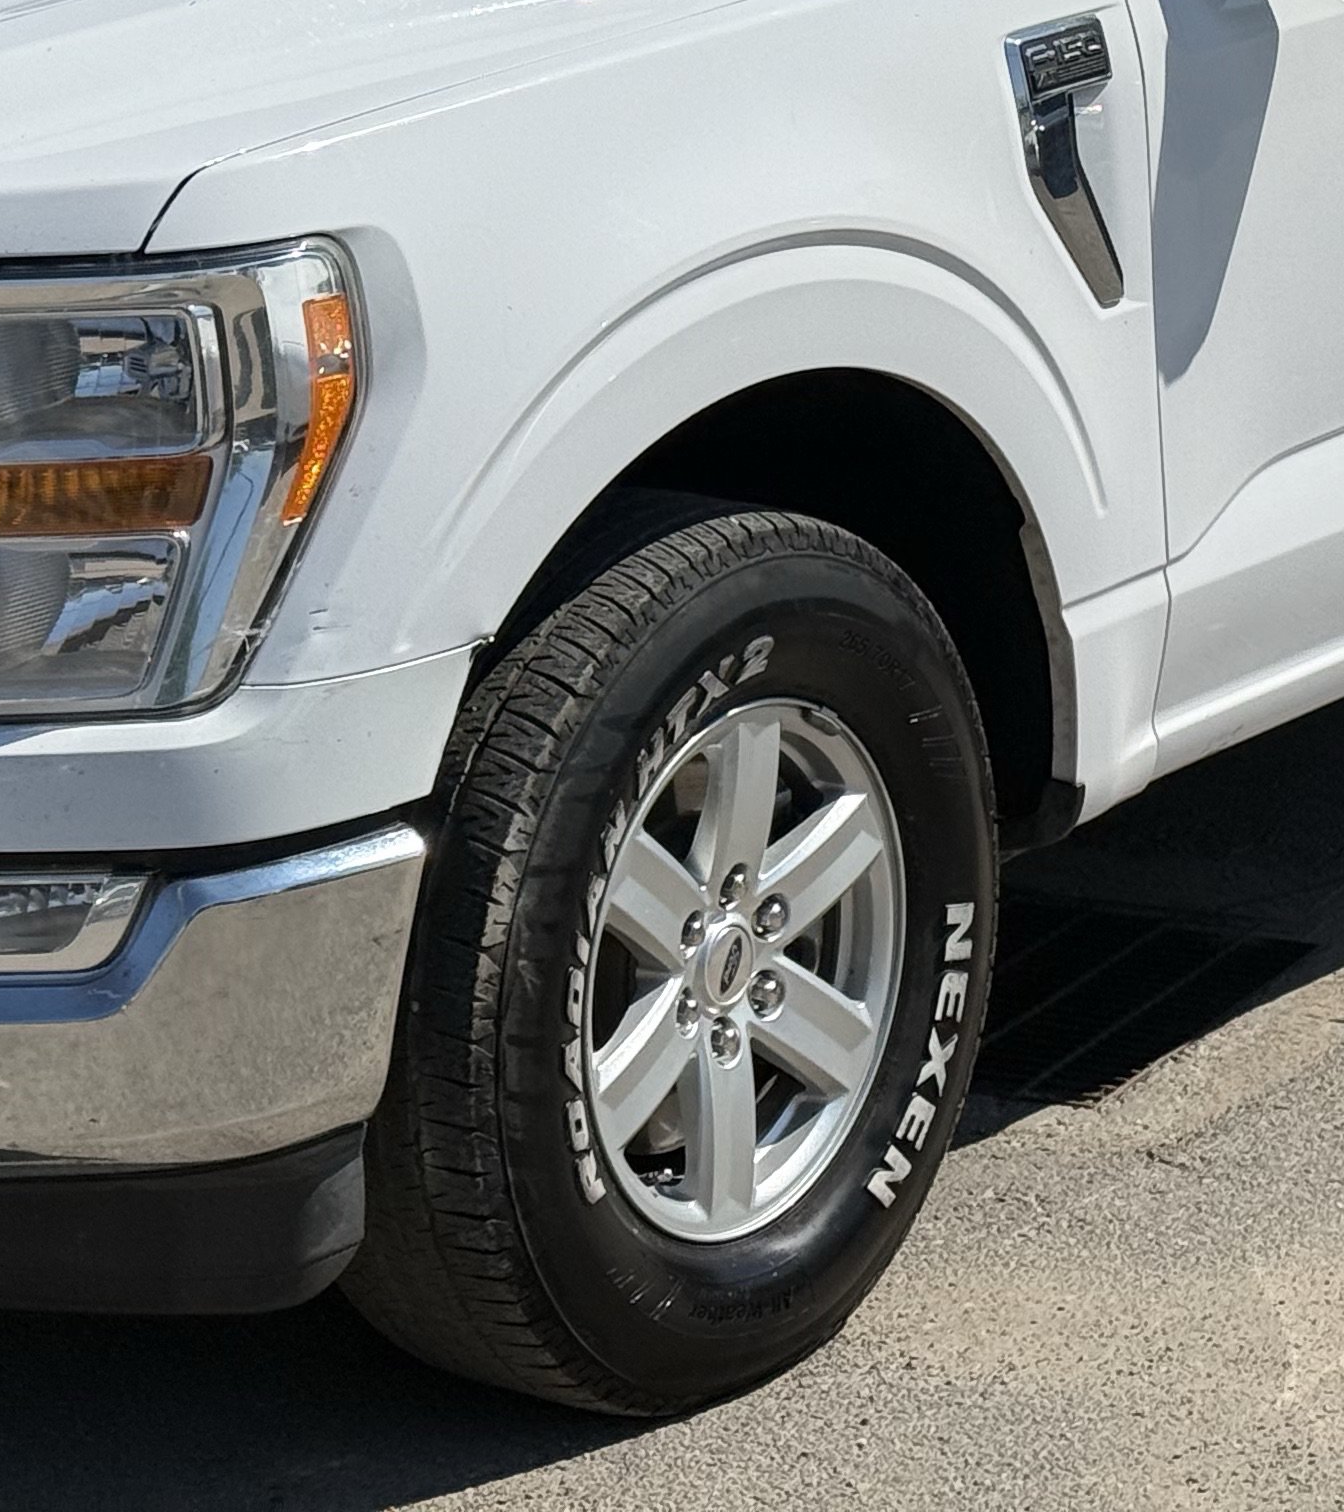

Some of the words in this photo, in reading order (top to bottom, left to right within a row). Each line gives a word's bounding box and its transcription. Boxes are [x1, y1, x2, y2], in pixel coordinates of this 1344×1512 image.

[1025, 30, 1102, 72] F-150
[637, 635, 776, 802] HTX2
[866, 901, 975, 1208] NEXEN
